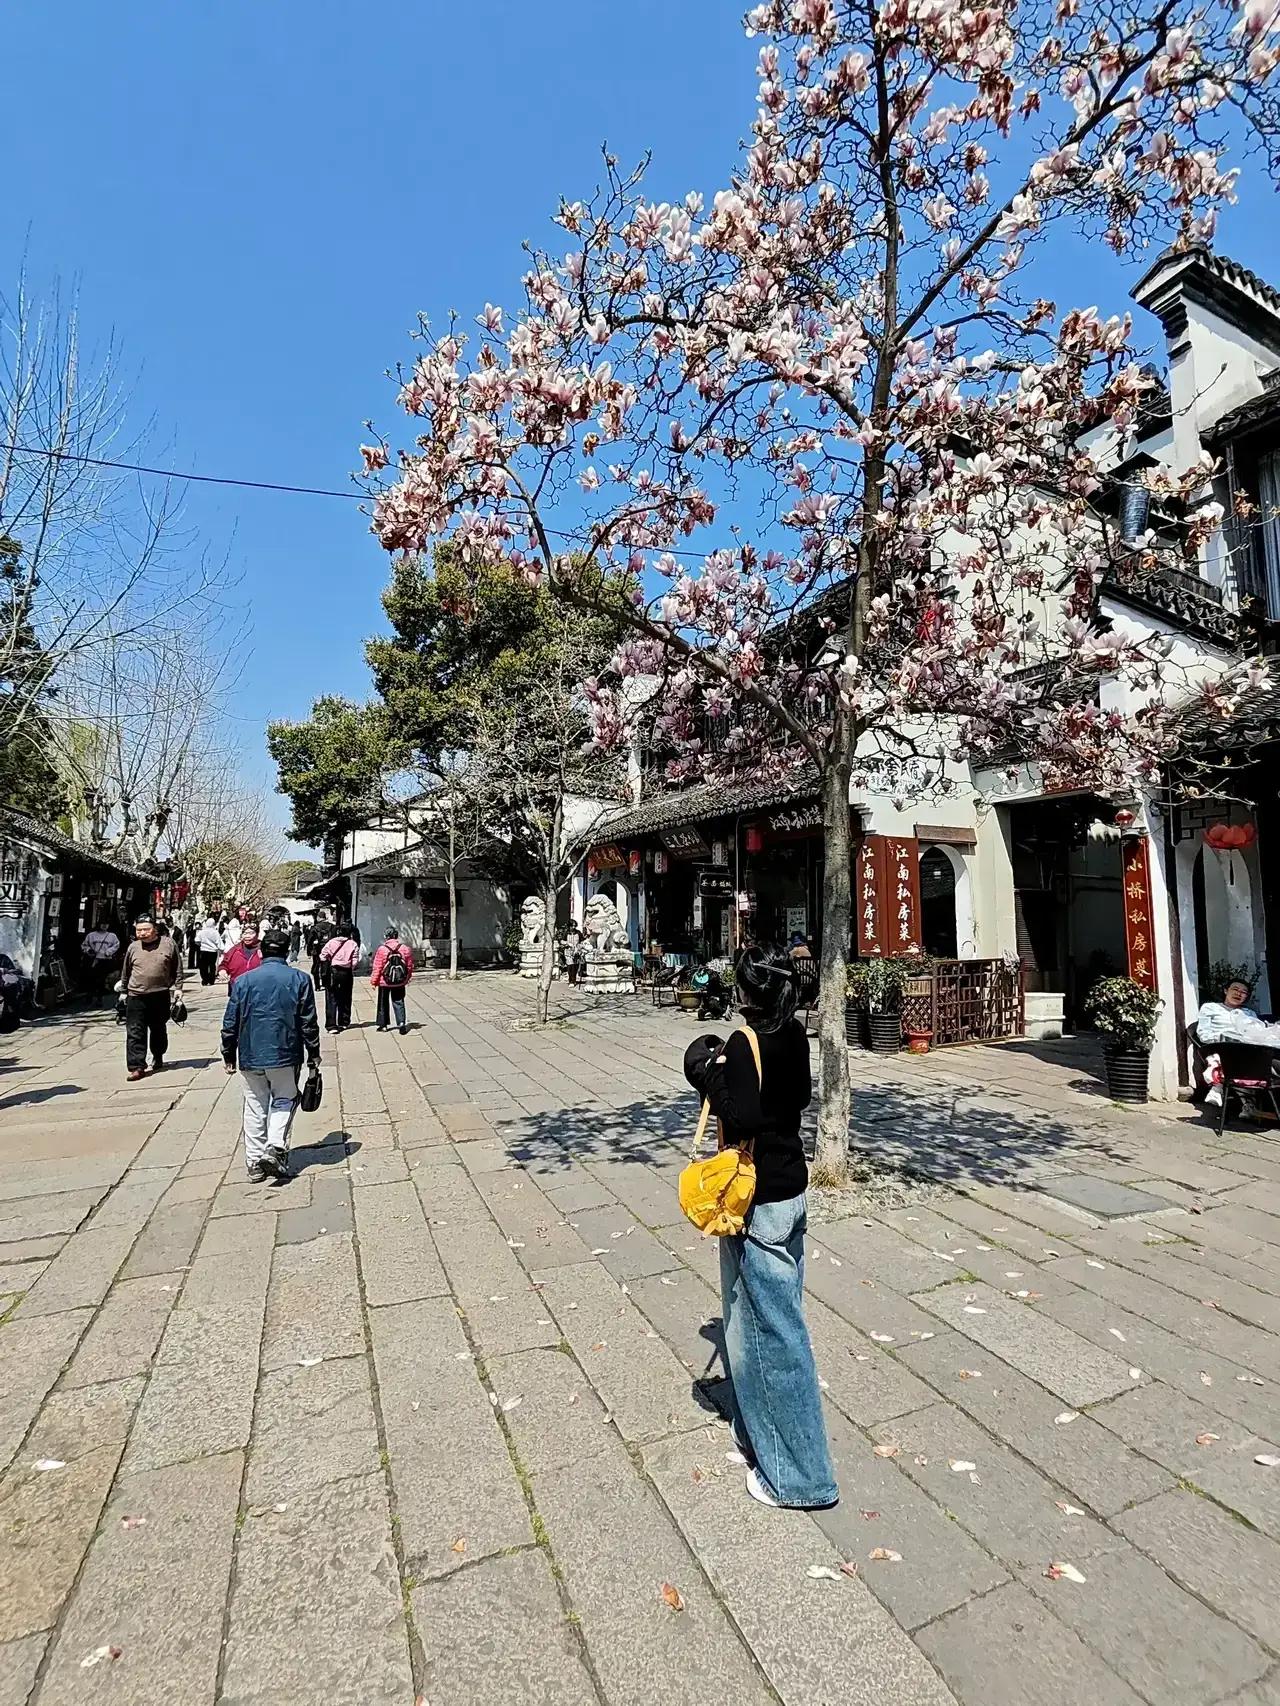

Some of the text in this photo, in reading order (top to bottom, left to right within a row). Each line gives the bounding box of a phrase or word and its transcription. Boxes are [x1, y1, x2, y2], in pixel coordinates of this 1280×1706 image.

[861, 845, 876, 941] 江南私房菜
[895, 844, 911, 941] 江南私房菜
[1126, 858, 1151, 978] 小桥私房菜
